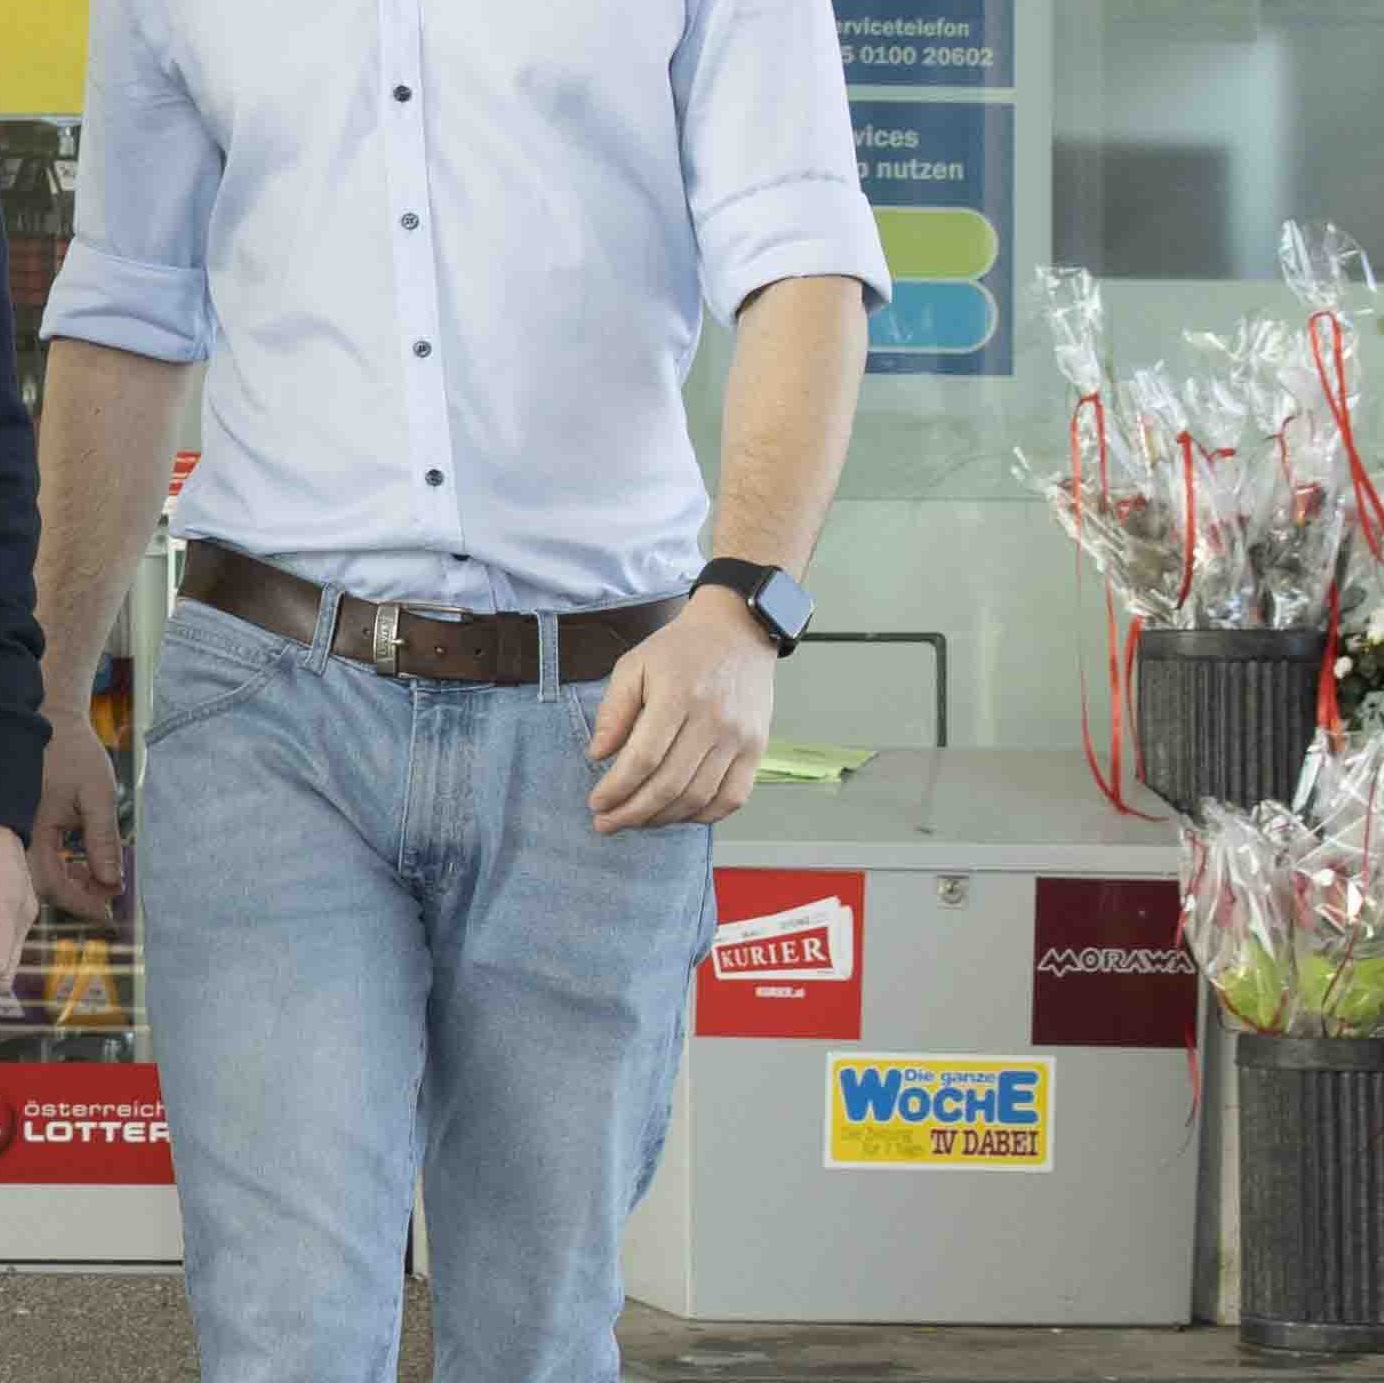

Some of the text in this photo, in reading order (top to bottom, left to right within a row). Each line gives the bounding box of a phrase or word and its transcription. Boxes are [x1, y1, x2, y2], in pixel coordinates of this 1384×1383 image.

[859, 46, 917, 65] 0100
[922, 46, 994, 66] 20602
[878, 158, 965, 180] nutzen
[721, 936, 827, 968] KURIER
[1036, 946, 1196, 978] MORAWA
[904, 1069, 995, 1086] Die ganze
[839, 1068, 1039, 1124] WOCHE
[961, 1130, 1039, 1157] DABEI
